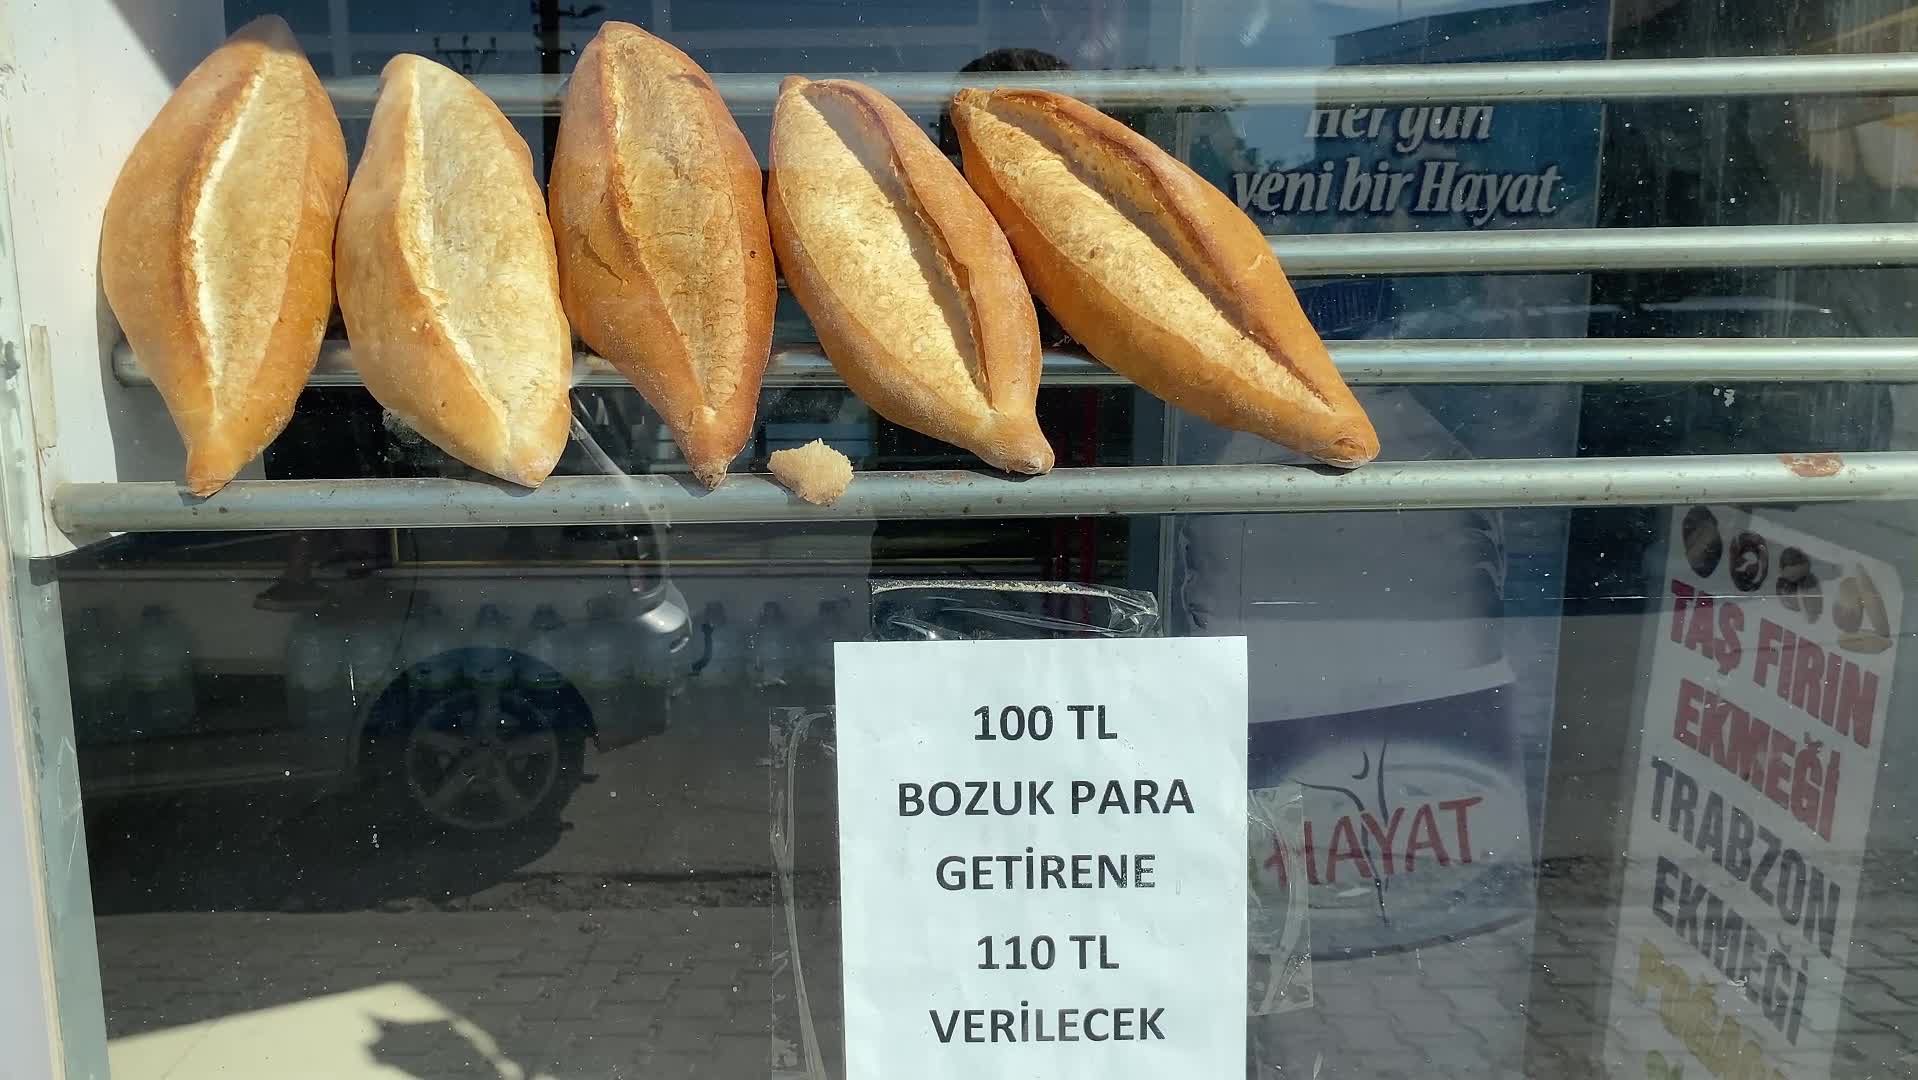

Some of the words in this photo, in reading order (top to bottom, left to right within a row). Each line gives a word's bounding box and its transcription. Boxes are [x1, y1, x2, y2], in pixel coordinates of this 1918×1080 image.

[1233, 160, 1336, 214] yeni
[1338, 156, 1414, 213] bir
[1413, 161, 1563, 227] Hayat
[1670, 578, 1745, 676] TAŞ
[1753, 617, 1879, 749] FIRIN
[973, 705, 1054, 741] 100
[1067, 704, 1118, 740] TL
[899, 780, 1055, 817] BOZUK
[1071, 779, 1195, 815] PARA
[1263, 796, 1484, 888] HAYAT
[1651, 755, 1841, 960] TRABZON
[935, 846, 1156, 891] GETİRENE
[977, 935, 1056, 970] 110
[1069, 934, 1120, 970] TL
[928, 1000, 1166, 1043] VERİLECEK
